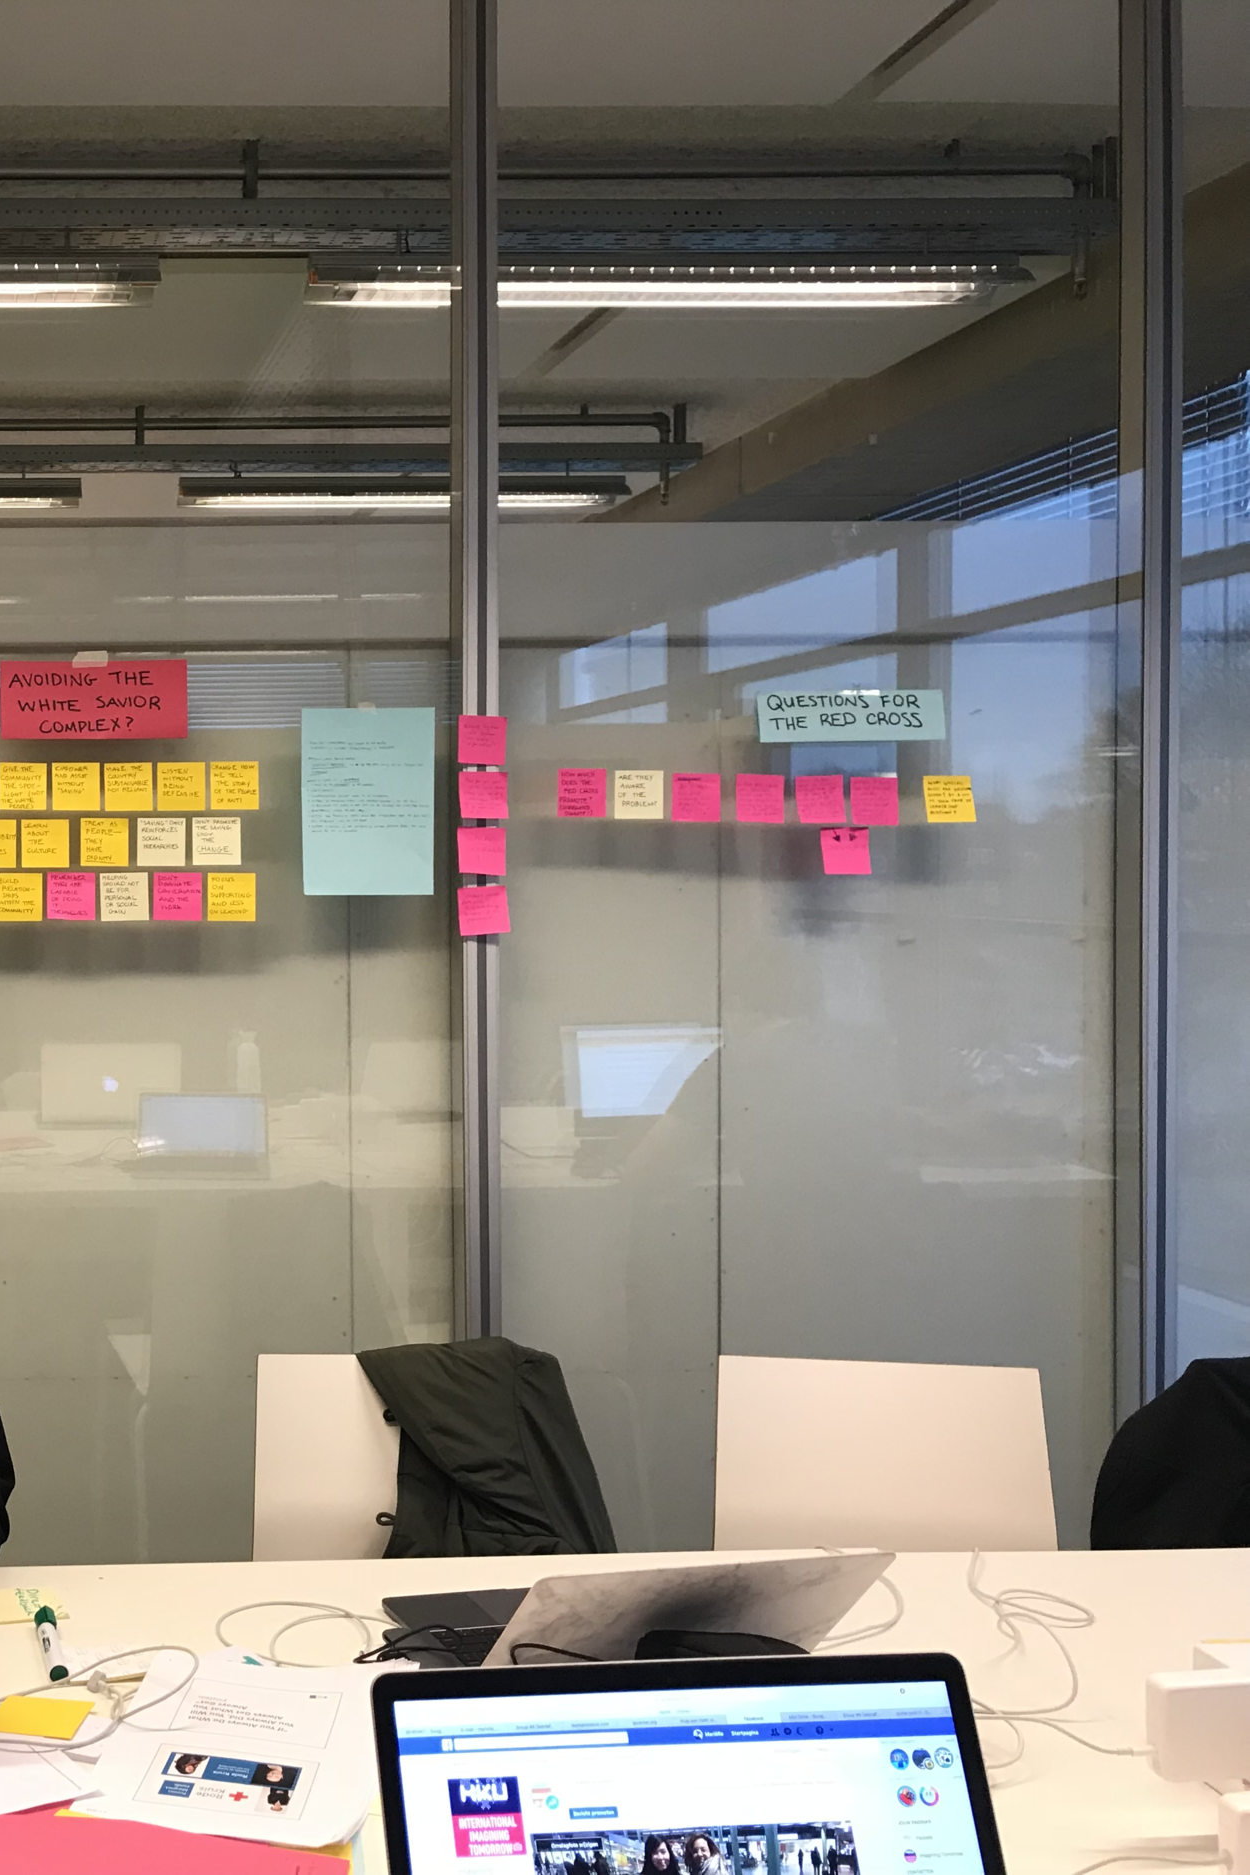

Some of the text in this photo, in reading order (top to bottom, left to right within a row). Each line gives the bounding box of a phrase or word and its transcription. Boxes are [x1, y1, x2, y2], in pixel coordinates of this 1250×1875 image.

[8, 671, 154, 688] AVOIDING THE
[18, 695, 161, 712] WHITE SAVIOR
[766, 694, 921, 712] QUESTIONS FOR
[39, 716, 134, 734] COMPLEX?
[769, 712, 923, 731] THE RED CROSS
[195, 845, 230, 853] CHANGE
[188, 1715, 211, 1723] What
[246, 1716, 277, 1725] Always
[253, 1712, 283, 1720] Always
[227, 1720, 258, 1728] Always
[196, 1791, 223, 1799] Rode
[198, 1786, 225, 1795] Kruis
[459, 1782, 508, 1802] HKU
[458, 1816, 517, 1829] INTERNATIONAL
[469, 1829, 510, 1841] IMAGINING
[469, 1843, 513, 1856] TOMORROW
